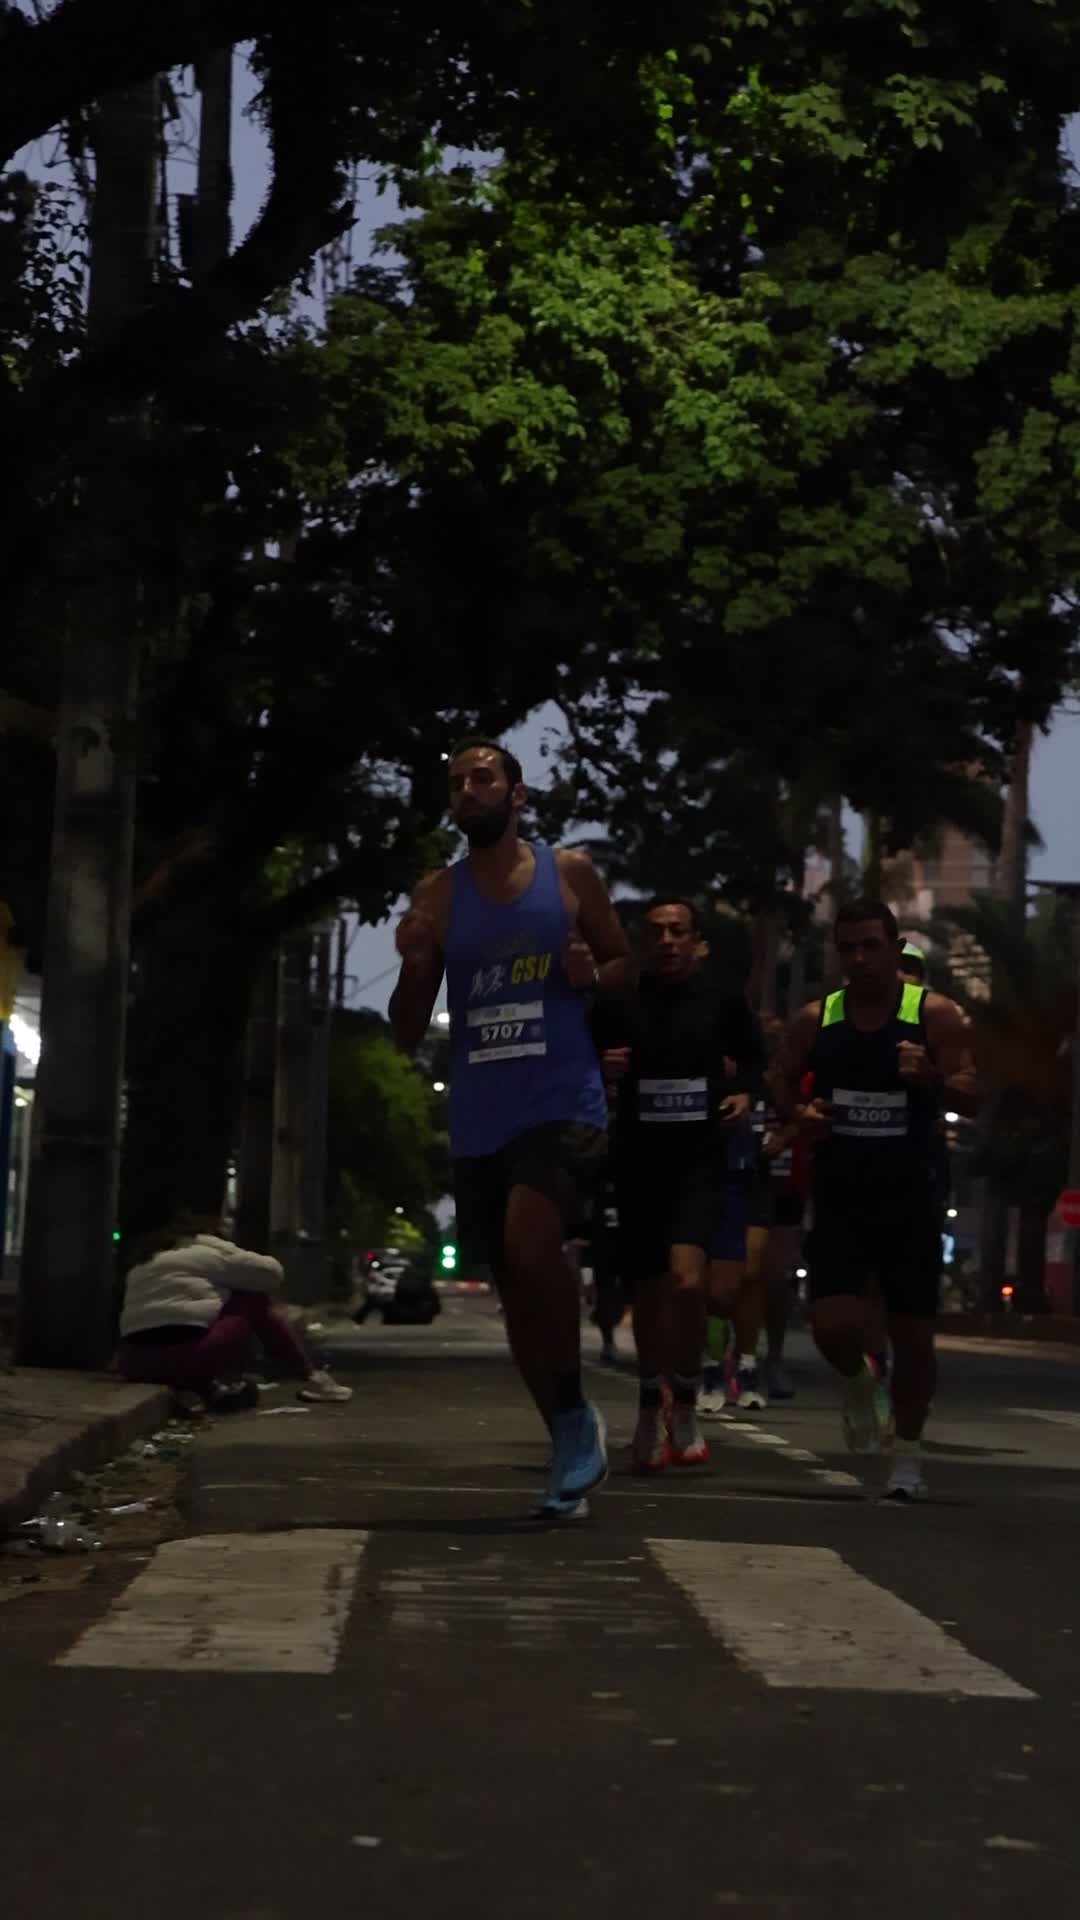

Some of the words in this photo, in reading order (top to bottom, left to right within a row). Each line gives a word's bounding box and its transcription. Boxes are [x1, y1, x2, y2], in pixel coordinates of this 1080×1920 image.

[511, 952, 551, 985] CSU
[480, 1021, 524, 1043] 5707
[848, 1108, 891, 1122] 6200
